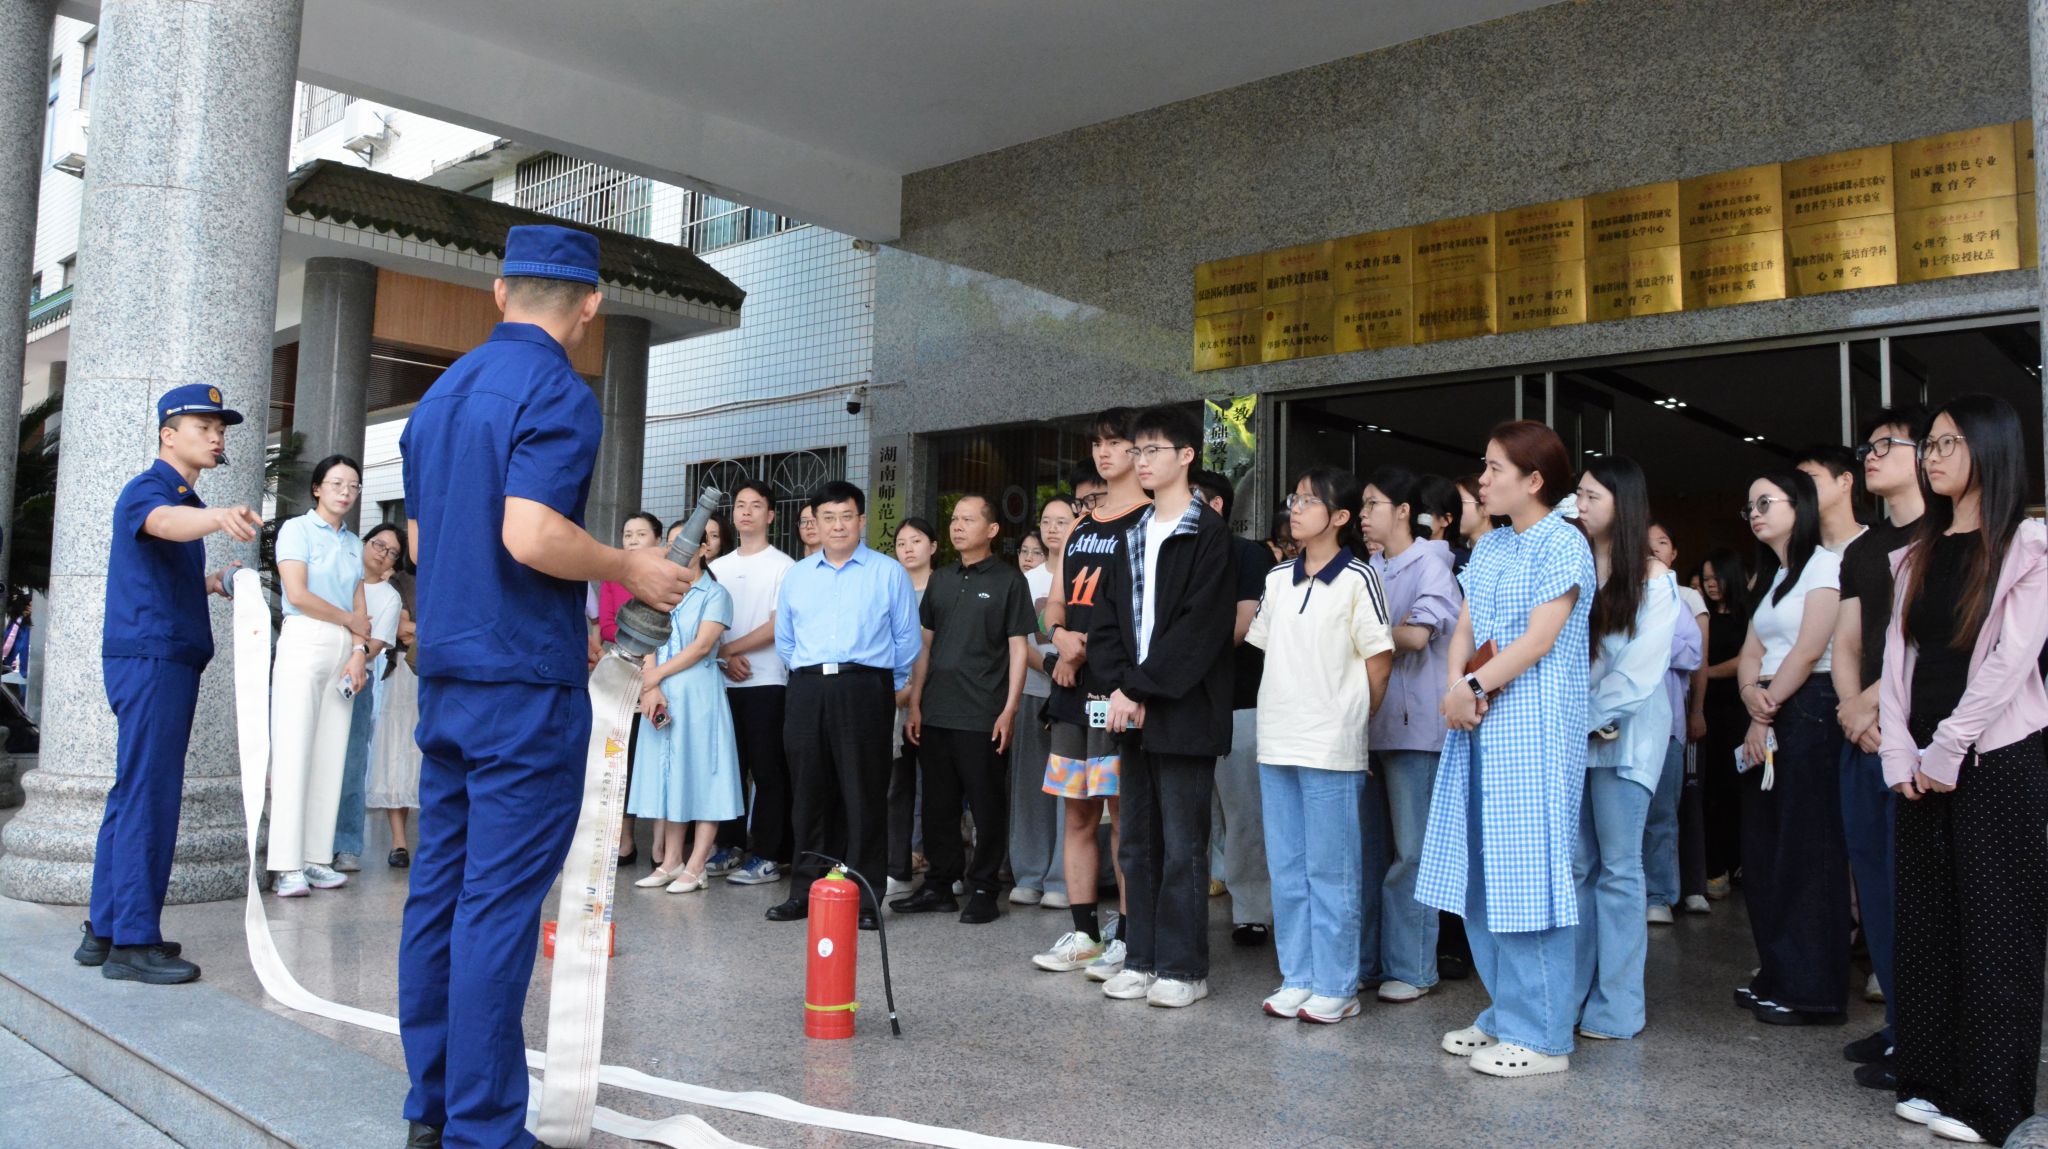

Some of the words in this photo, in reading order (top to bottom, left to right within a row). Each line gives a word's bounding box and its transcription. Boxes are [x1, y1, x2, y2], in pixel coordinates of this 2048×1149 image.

[1910, 155, 1998, 180] 国家级特色专业
[1930, 176, 1977, 194] 教育学
[1912, 228, 2001, 251] 心理学一级学科
[1919, 248, 1995, 269] 博士学位授权点
[1817, 266, 1862, 282] 心理学
[1067, 566, 1102, 607] 11
